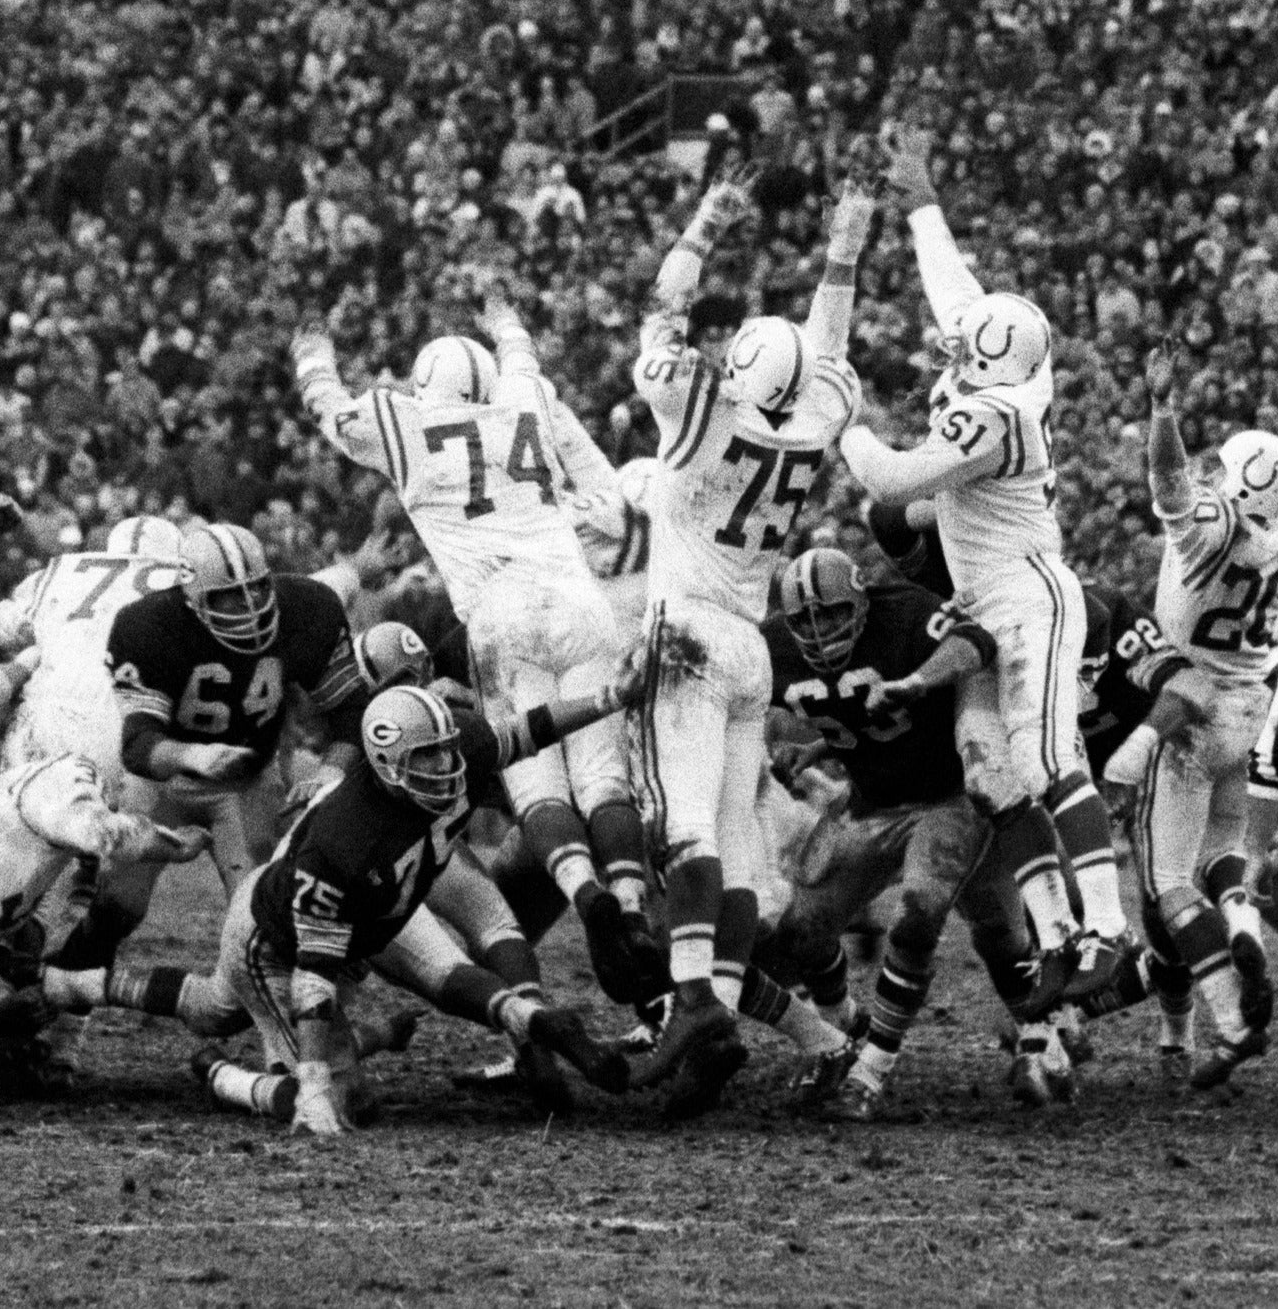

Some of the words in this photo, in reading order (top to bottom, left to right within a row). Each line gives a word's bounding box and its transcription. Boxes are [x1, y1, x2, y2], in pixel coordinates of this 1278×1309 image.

[423, 412, 558, 521] 74
[940, 410, 987, 455] 51
[714, 435, 825, 551] 75
[177, 657, 284, 734] 64
[292, 868, 345, 919] 75
